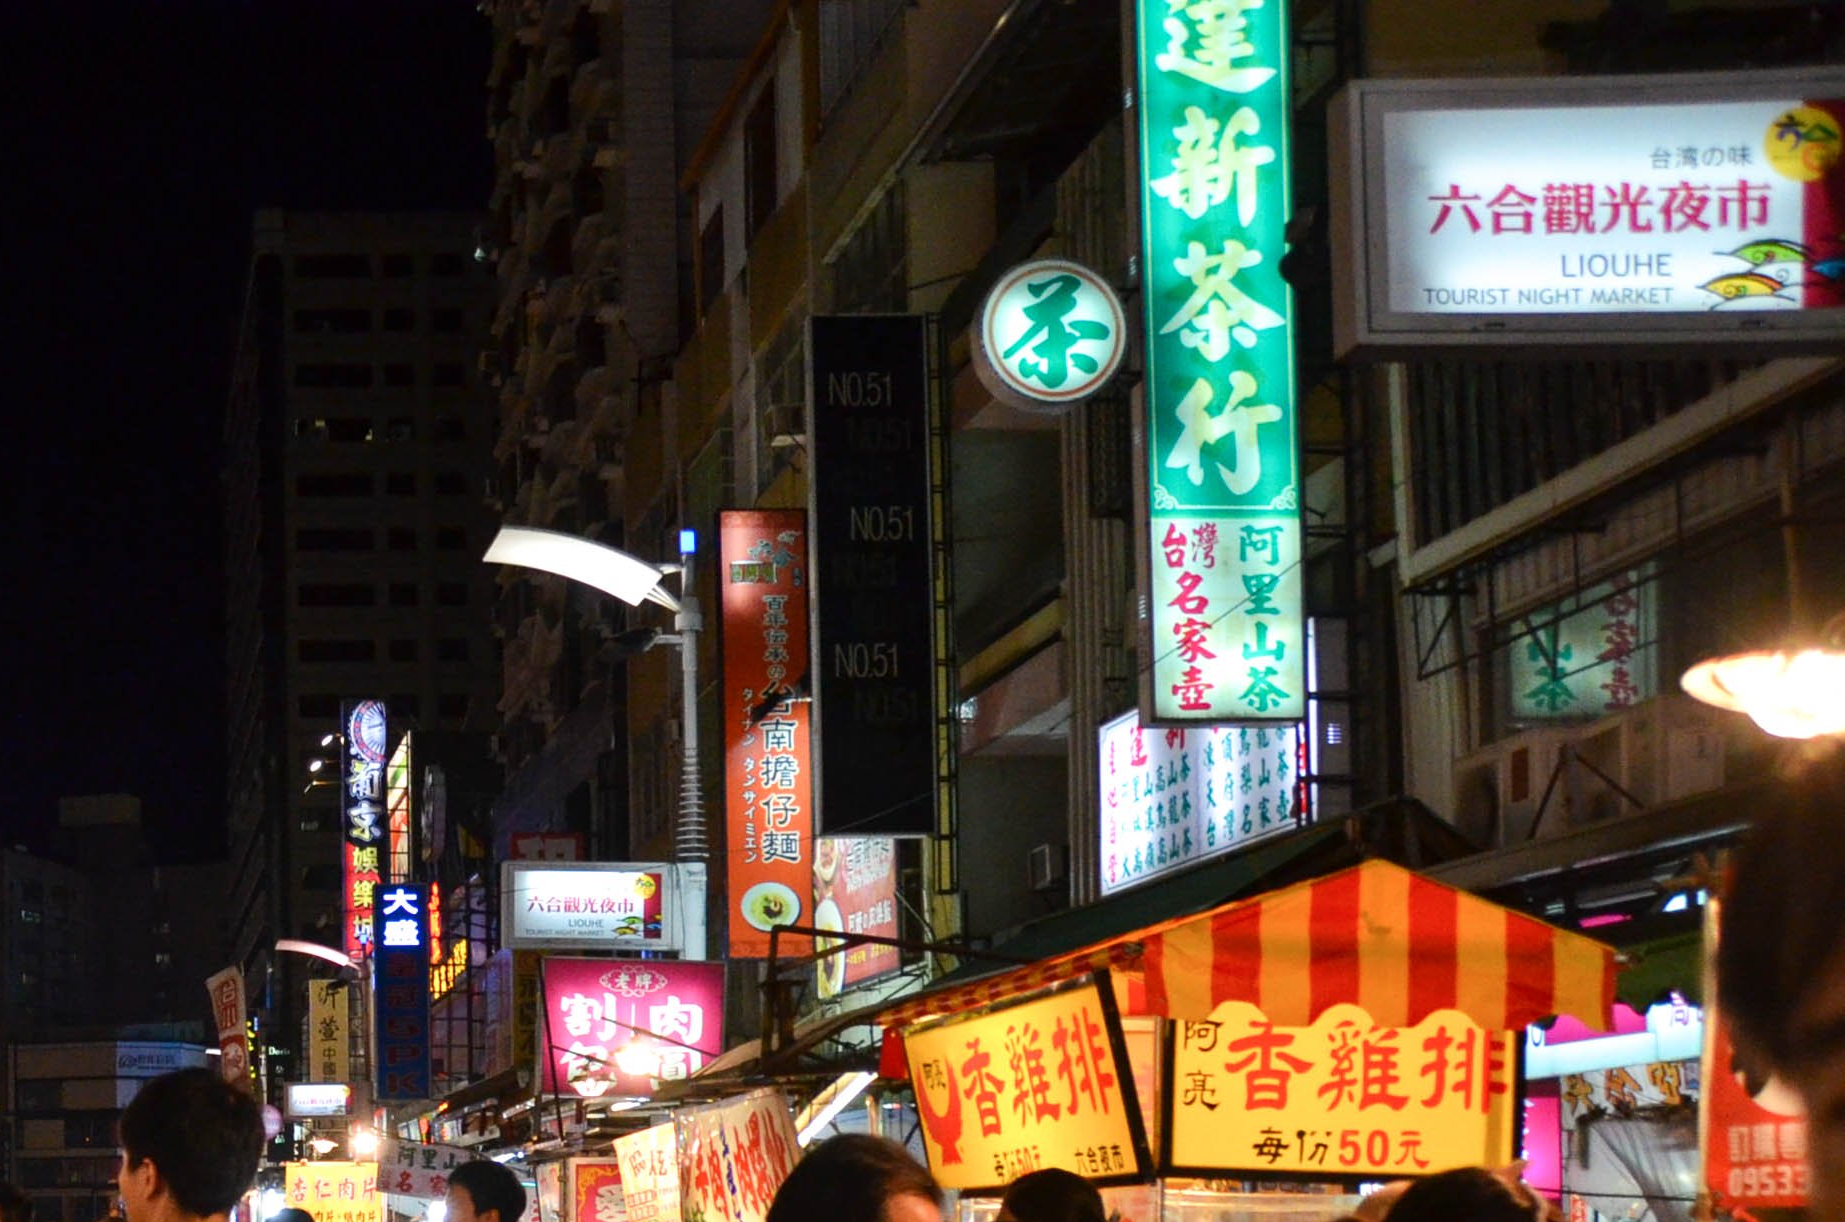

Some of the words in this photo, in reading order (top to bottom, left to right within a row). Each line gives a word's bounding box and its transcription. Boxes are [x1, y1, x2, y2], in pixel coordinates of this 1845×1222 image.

[1649, 145, 1752, 169] 台湾の味
[1428, 179, 1772, 235] 六合觀光夜市
[1561, 253, 1673, 279] LIOUHE
[1424, 287, 1510, 306] TOURIST
[1518, 287, 1584, 305] NIGHT
[1590, 286, 1673, 304] MARKET
[1002, 275, 1111, 390] 茶
[850, 505, 915, 542] NO.51
[1238, 523, 1291, 713] 阿里山茶
[834, 642, 900, 679] NO.51
[527, 896, 635, 915] 六合觀光夜市
[568, 918, 604, 929] LIOUHE
[961, 1006, 1115, 1138] 香雞排
[1224, 1020, 1510, 1114] 香雞排
[1251, 1128, 1431, 1168] 每份50元
[292, 1176, 378, 1203] 杏仁肉片
